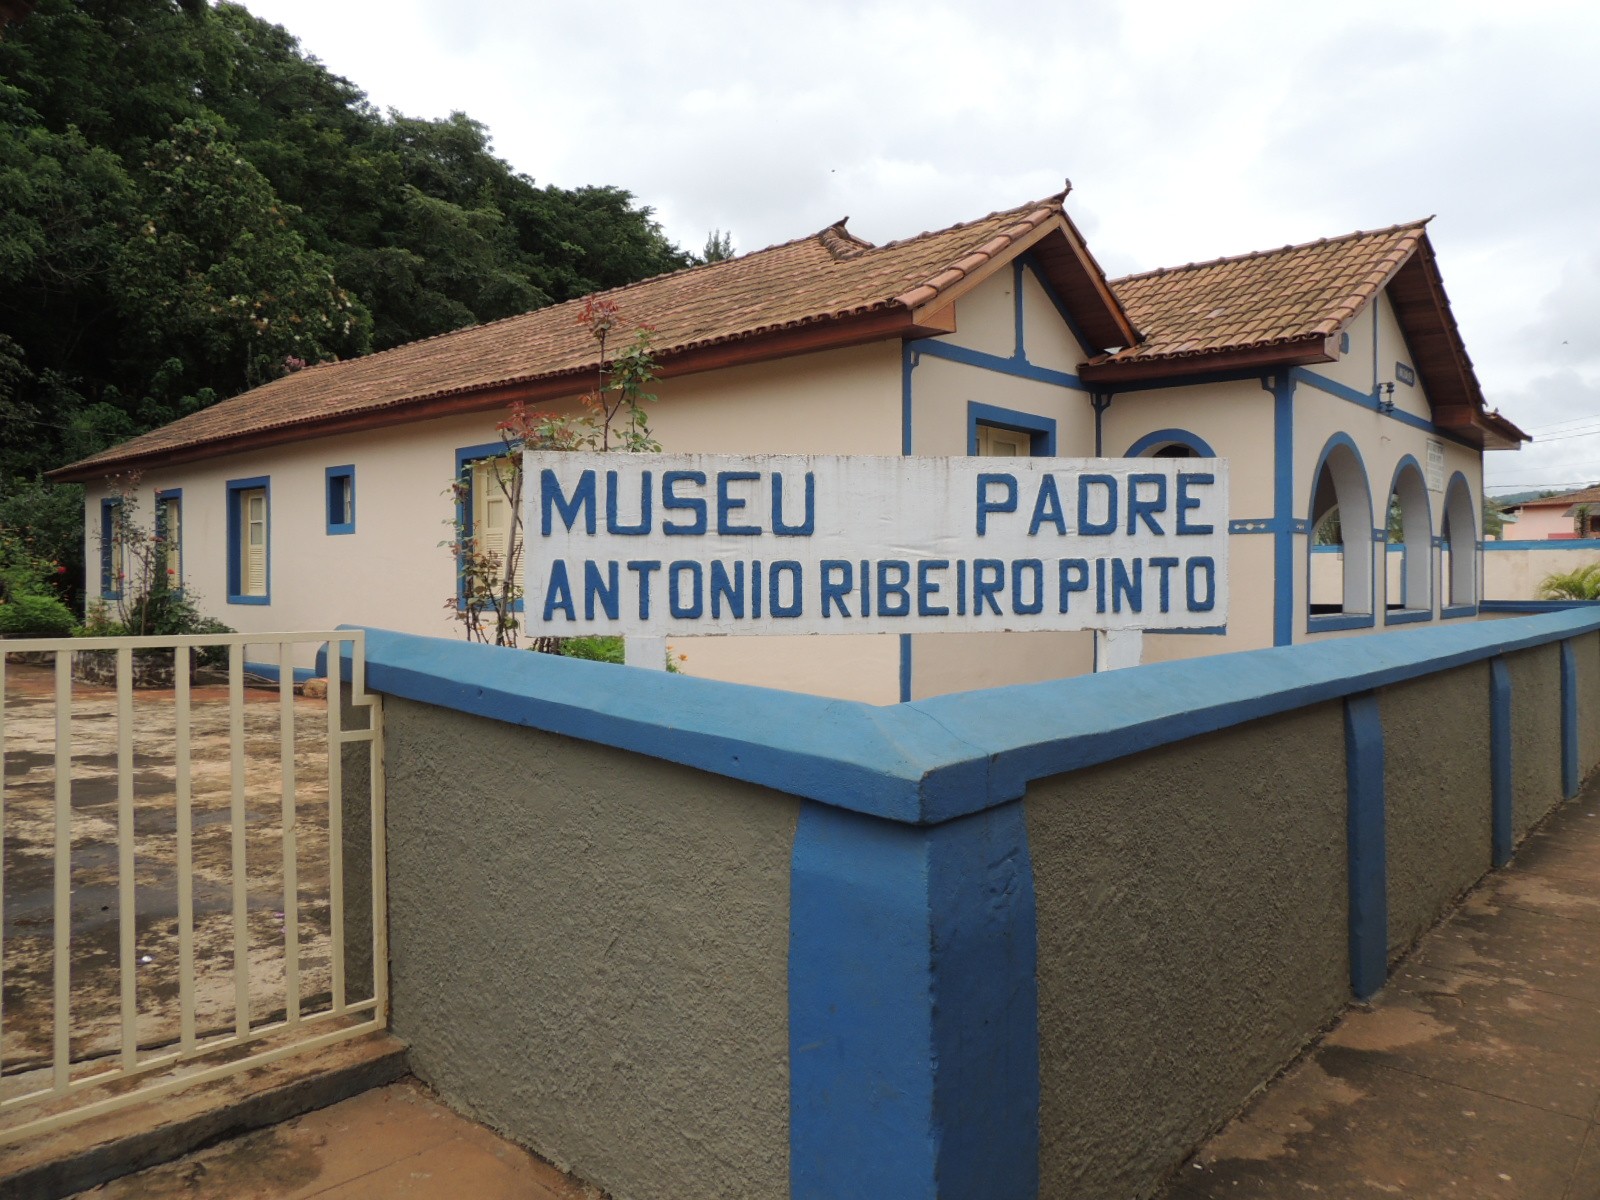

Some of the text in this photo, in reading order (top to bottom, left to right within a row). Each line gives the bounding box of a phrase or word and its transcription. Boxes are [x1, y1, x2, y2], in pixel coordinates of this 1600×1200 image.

[541, 470, 1215, 537] MUSEU PADRE
[543, 556, 1216, 621] ANTONIO RIBEIRO PINTO
